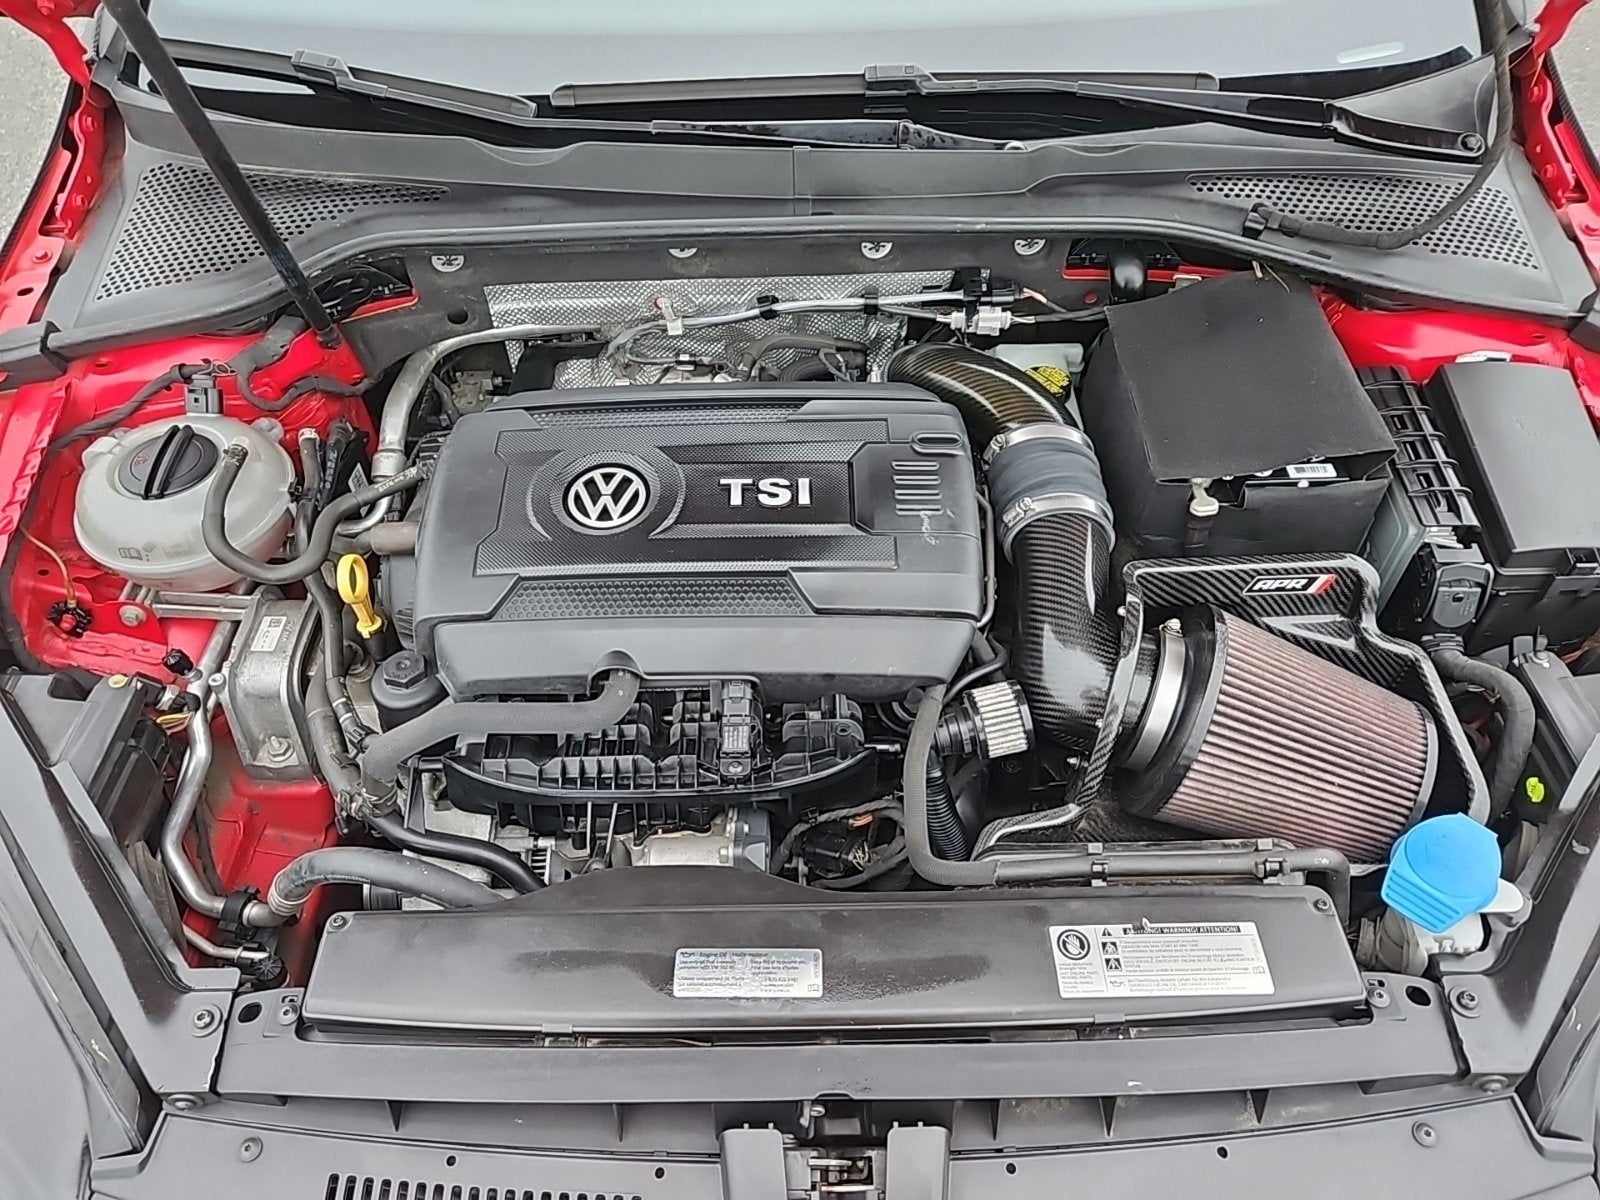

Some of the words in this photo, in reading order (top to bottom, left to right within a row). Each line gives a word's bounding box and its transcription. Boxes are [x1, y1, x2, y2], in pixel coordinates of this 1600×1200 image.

[568, 467, 646, 528] VW
[719, 477, 811, 507] TSI
[1252, 578, 1309, 590] APR
[1162, 926, 1198, 934] WARNING!
[1199, 925, 1239, 933] ATTENTION!
[699, 951, 719, 959] Engine
